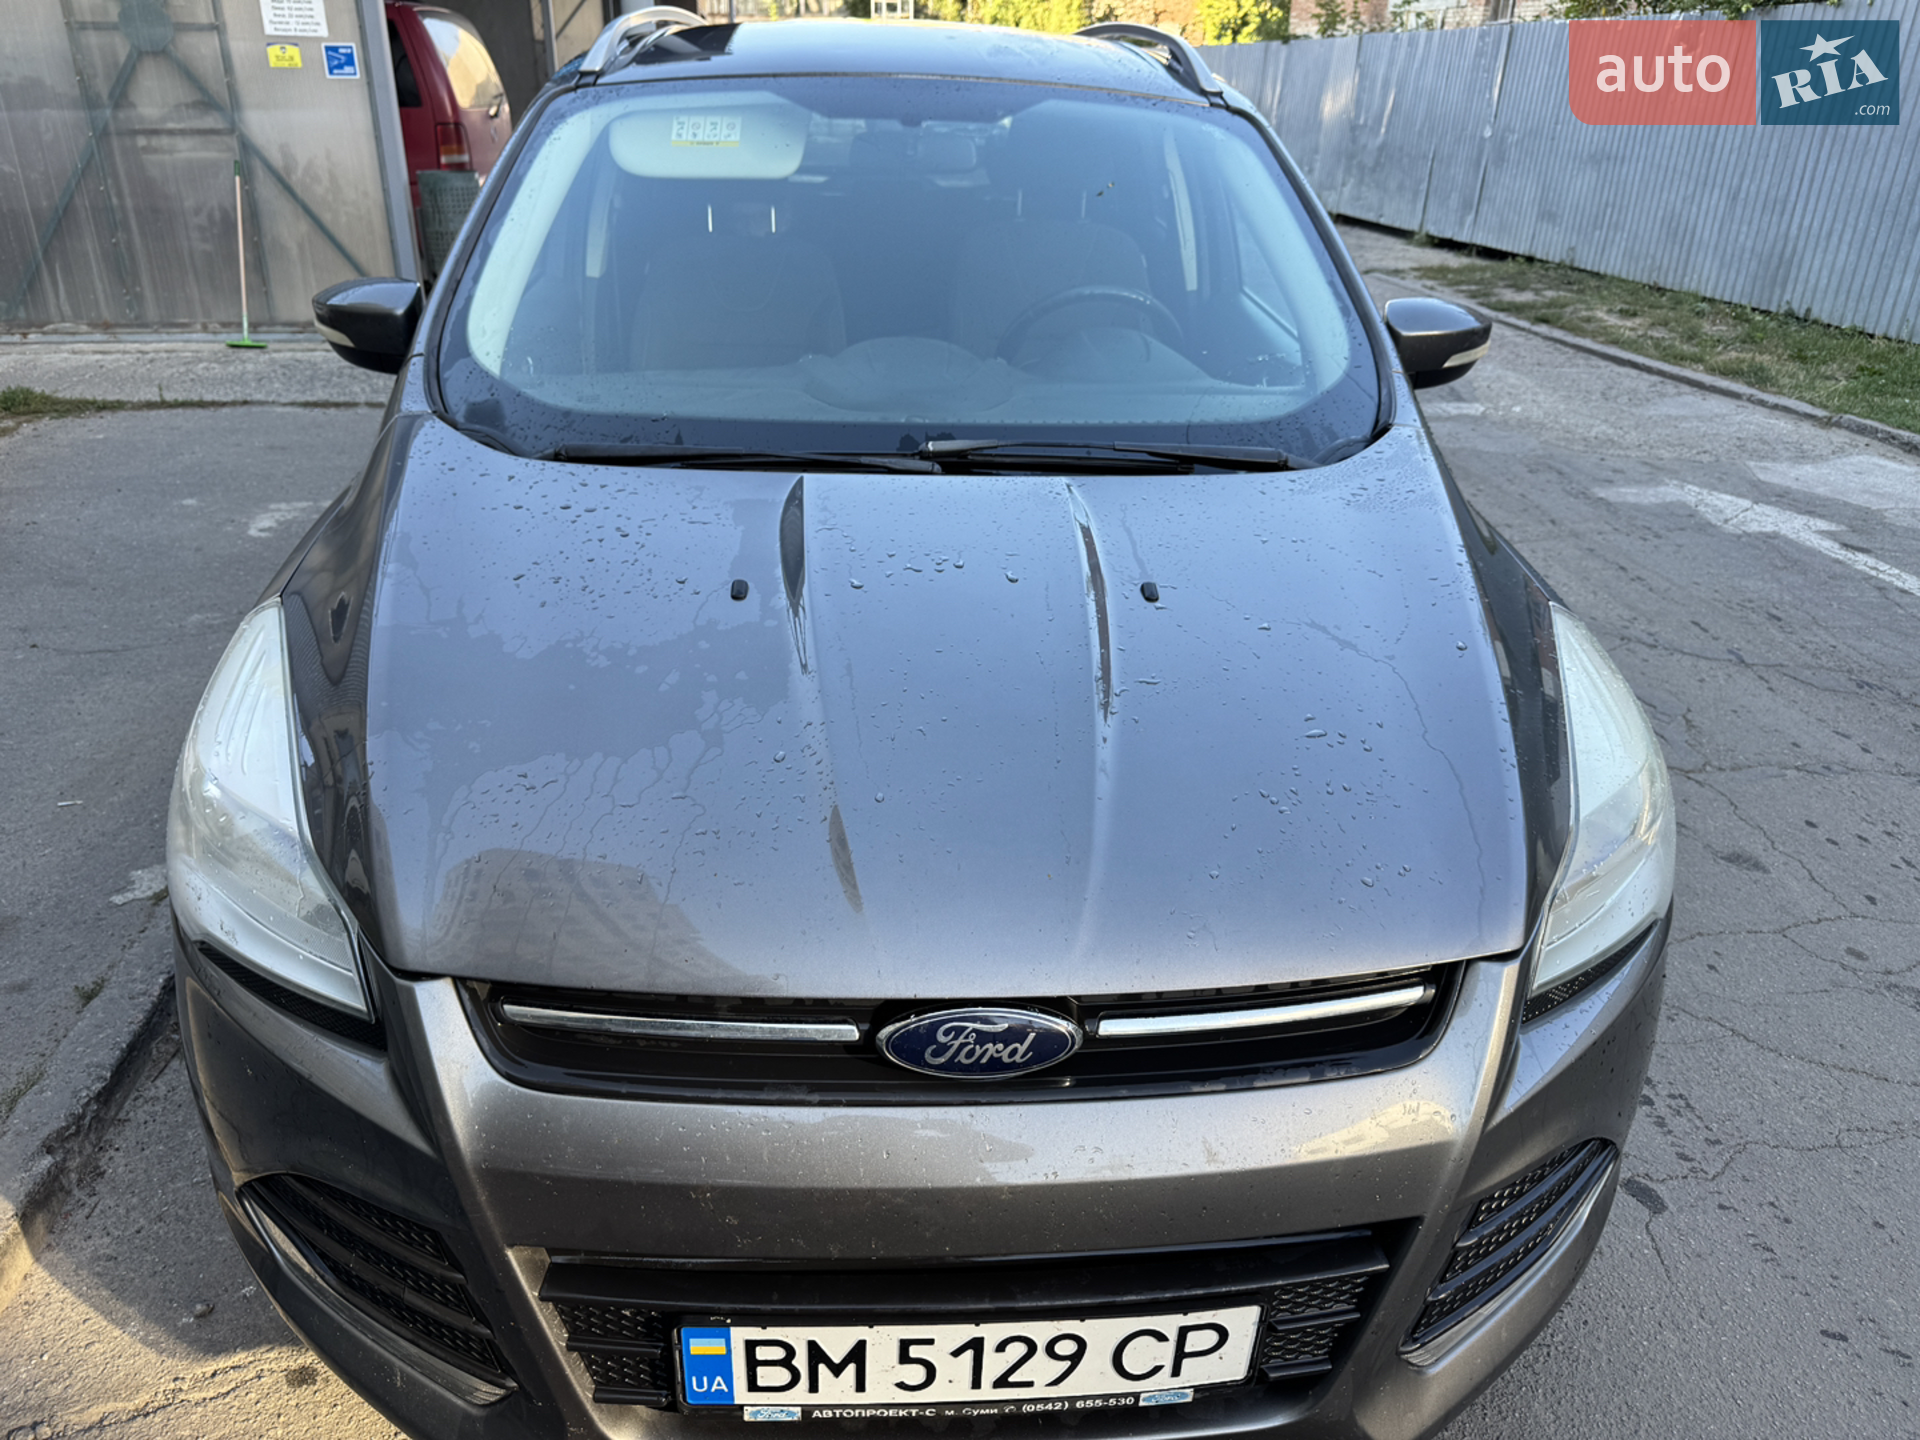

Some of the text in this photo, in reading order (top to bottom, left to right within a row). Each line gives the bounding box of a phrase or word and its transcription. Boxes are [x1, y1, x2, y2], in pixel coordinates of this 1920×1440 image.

[924, 1021, 1037, 1065] Ford
[744, 1322, 1231, 1394] BM 5129 CP
[692, 1376, 729, 1393] UA
[811, 1407, 937, 1419] АВТОПРОЕКТ-С
[961, 1406, 999, 1417] Суми
[1021, 1400, 1070, 1414] (0542)
[1075, 1396, 1136, 1410] 655-530
